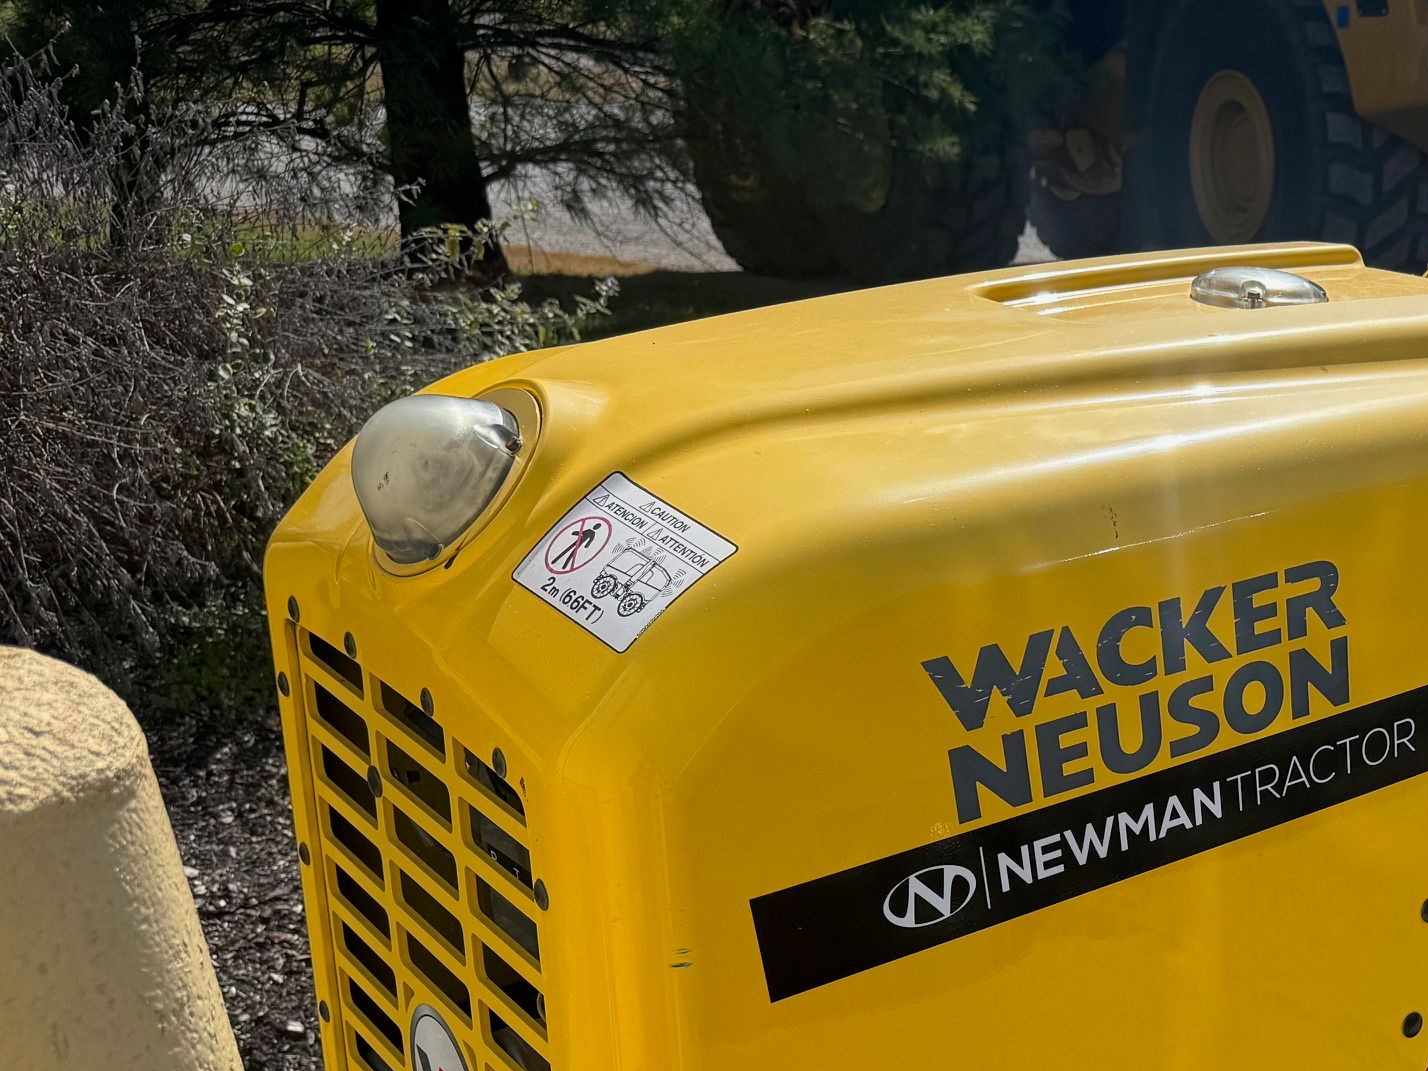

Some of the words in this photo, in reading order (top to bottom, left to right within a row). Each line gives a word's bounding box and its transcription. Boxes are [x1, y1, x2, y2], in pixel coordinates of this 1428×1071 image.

[605, 501, 649, 530] ATENCION
[650, 507, 691, 533] CAUTION
[658, 533, 710, 568] ATTENTIÓN
[920, 560, 1347, 732] WACKER
[947, 636, 1350, 825] NEUSON
